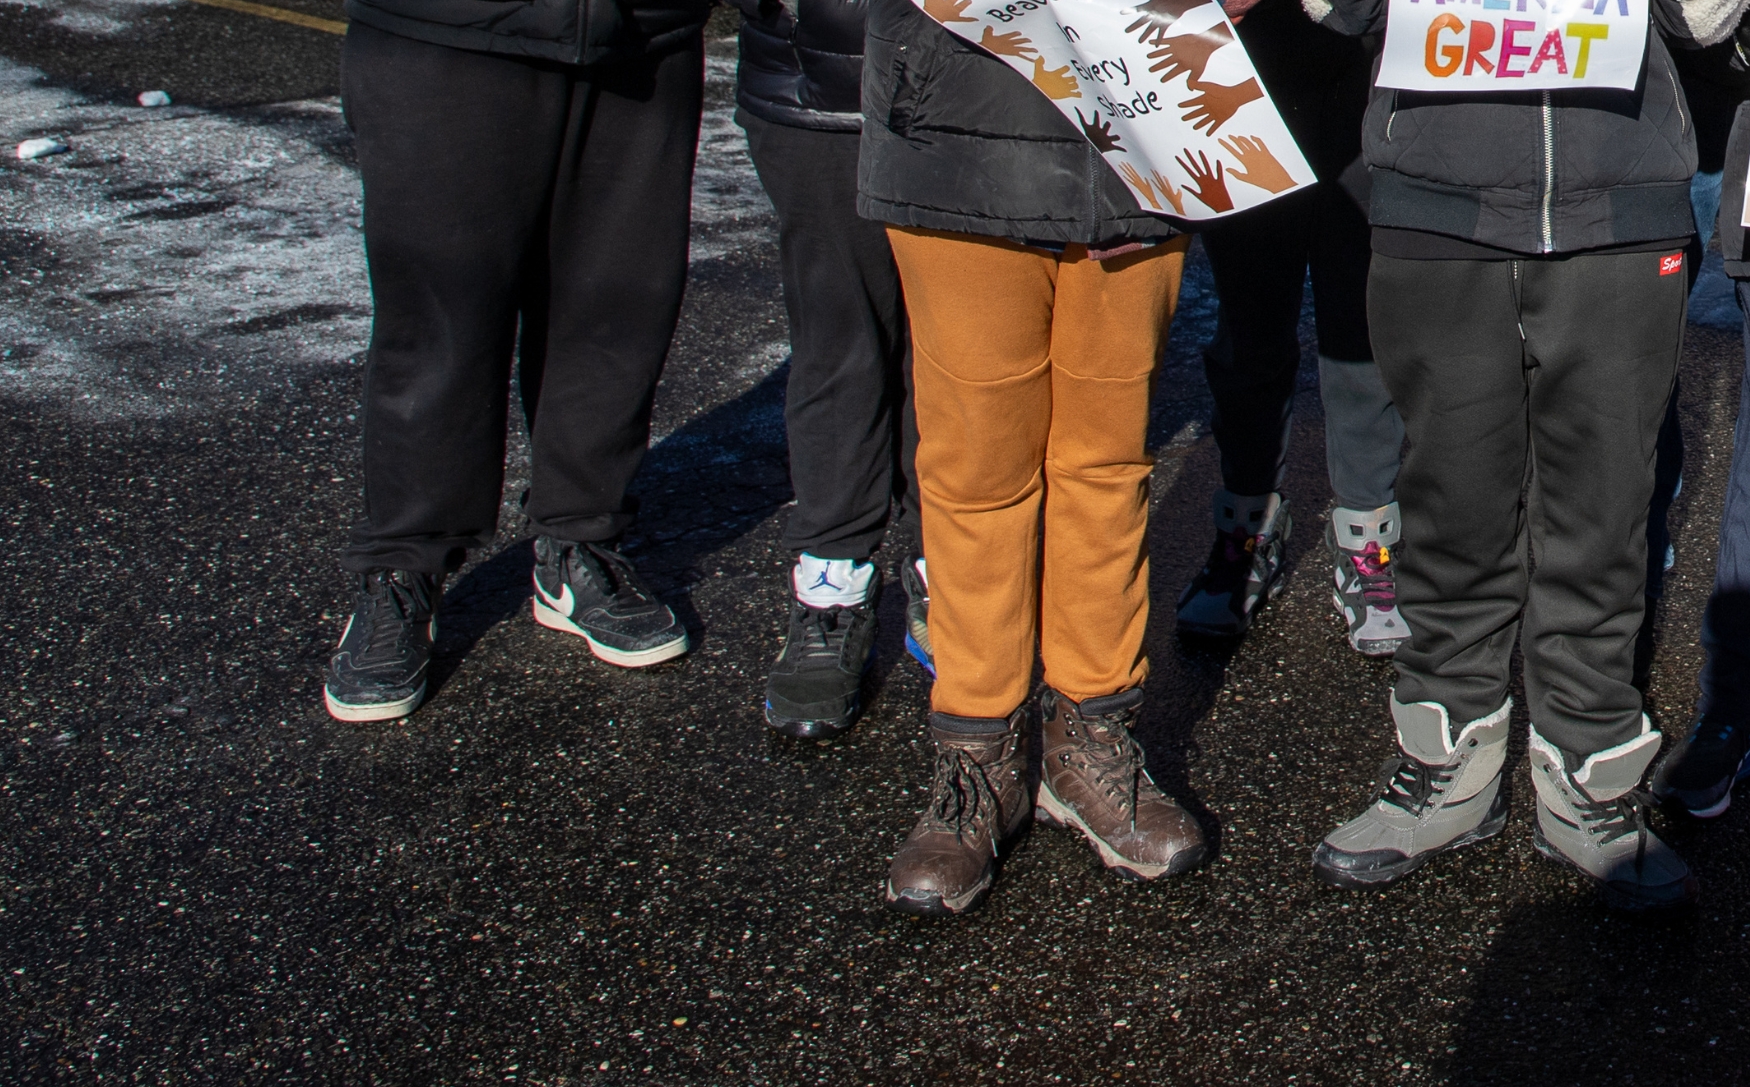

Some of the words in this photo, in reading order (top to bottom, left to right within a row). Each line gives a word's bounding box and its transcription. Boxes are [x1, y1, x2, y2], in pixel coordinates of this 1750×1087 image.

[1058, 21, 1080, 44] In
[1424, 12, 1609, 81] GREAT
[1071, 55, 1131, 86] Every
[1096, 88, 1163, 121] Shade
